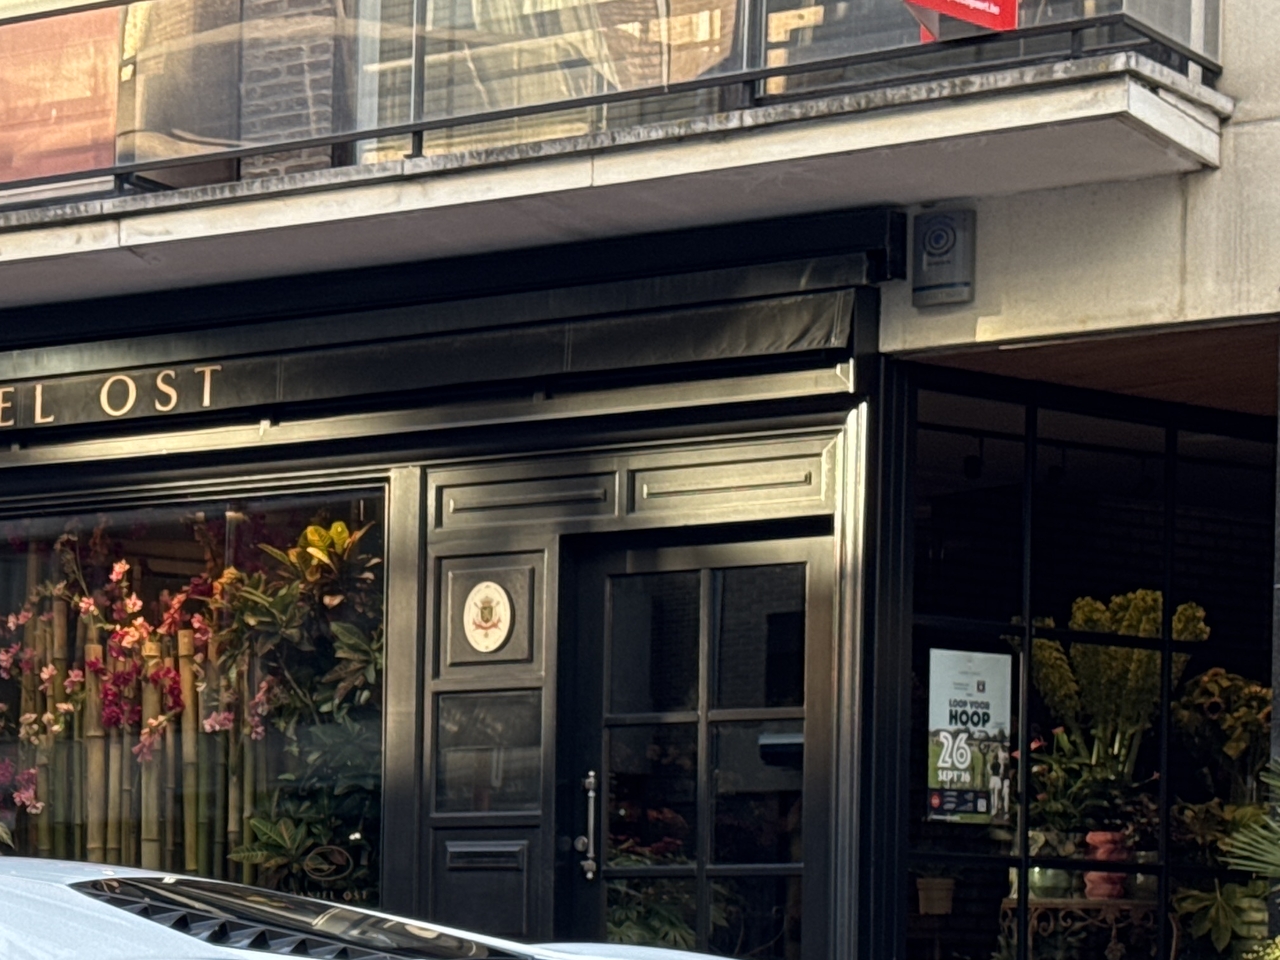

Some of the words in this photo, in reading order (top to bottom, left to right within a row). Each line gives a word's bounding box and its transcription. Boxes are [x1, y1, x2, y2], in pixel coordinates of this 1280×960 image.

[99, 365, 222, 417] OST
[948, 709, 990, 728] HOOP
[937, 731, 971, 770] 26
